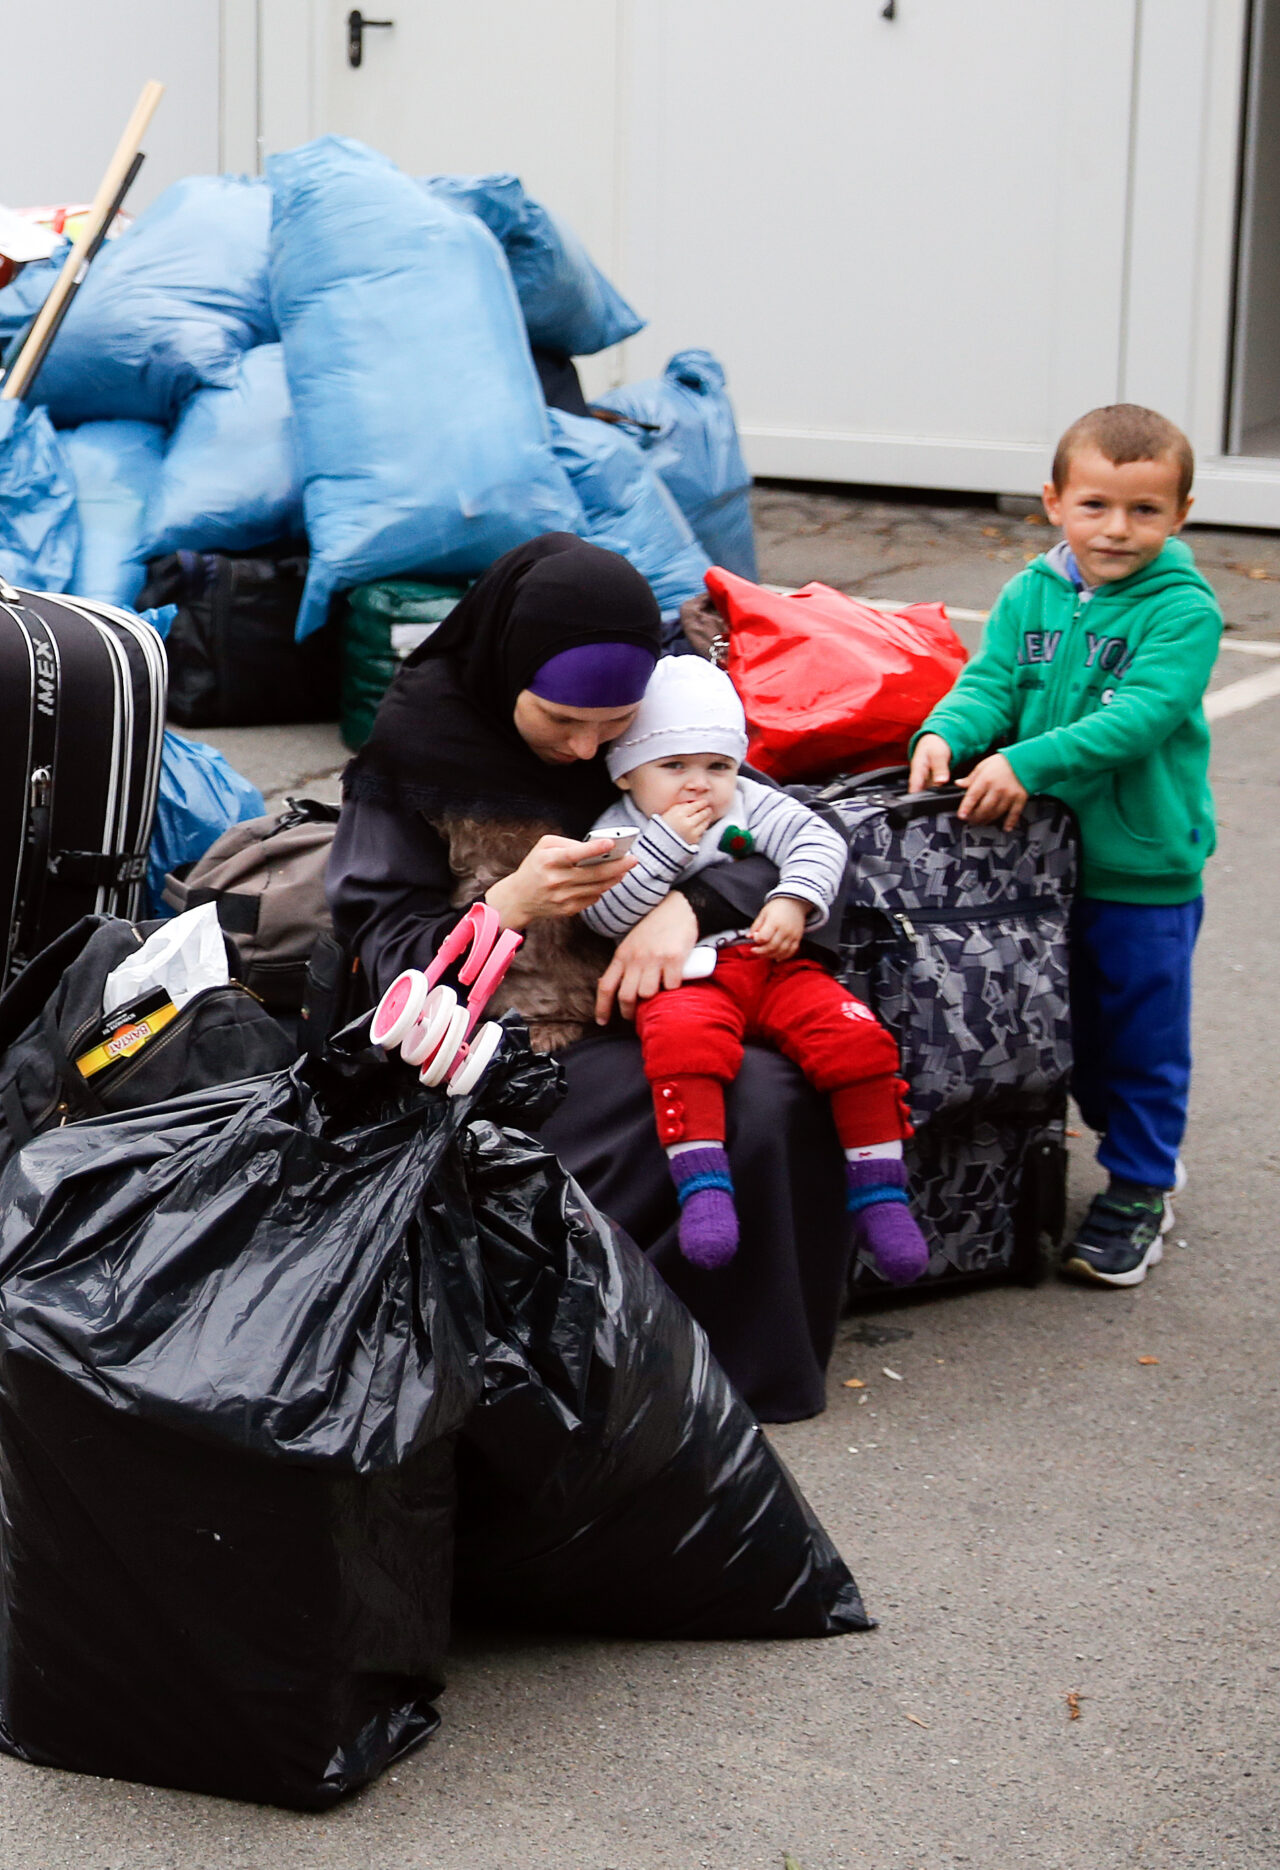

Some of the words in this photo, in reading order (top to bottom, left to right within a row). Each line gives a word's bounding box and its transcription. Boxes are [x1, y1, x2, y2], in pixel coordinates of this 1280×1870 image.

[1017, 630, 1063, 666] EW
[32, 637, 56, 717] IMEX
[108, 1024, 149, 1053] BAKTAT
